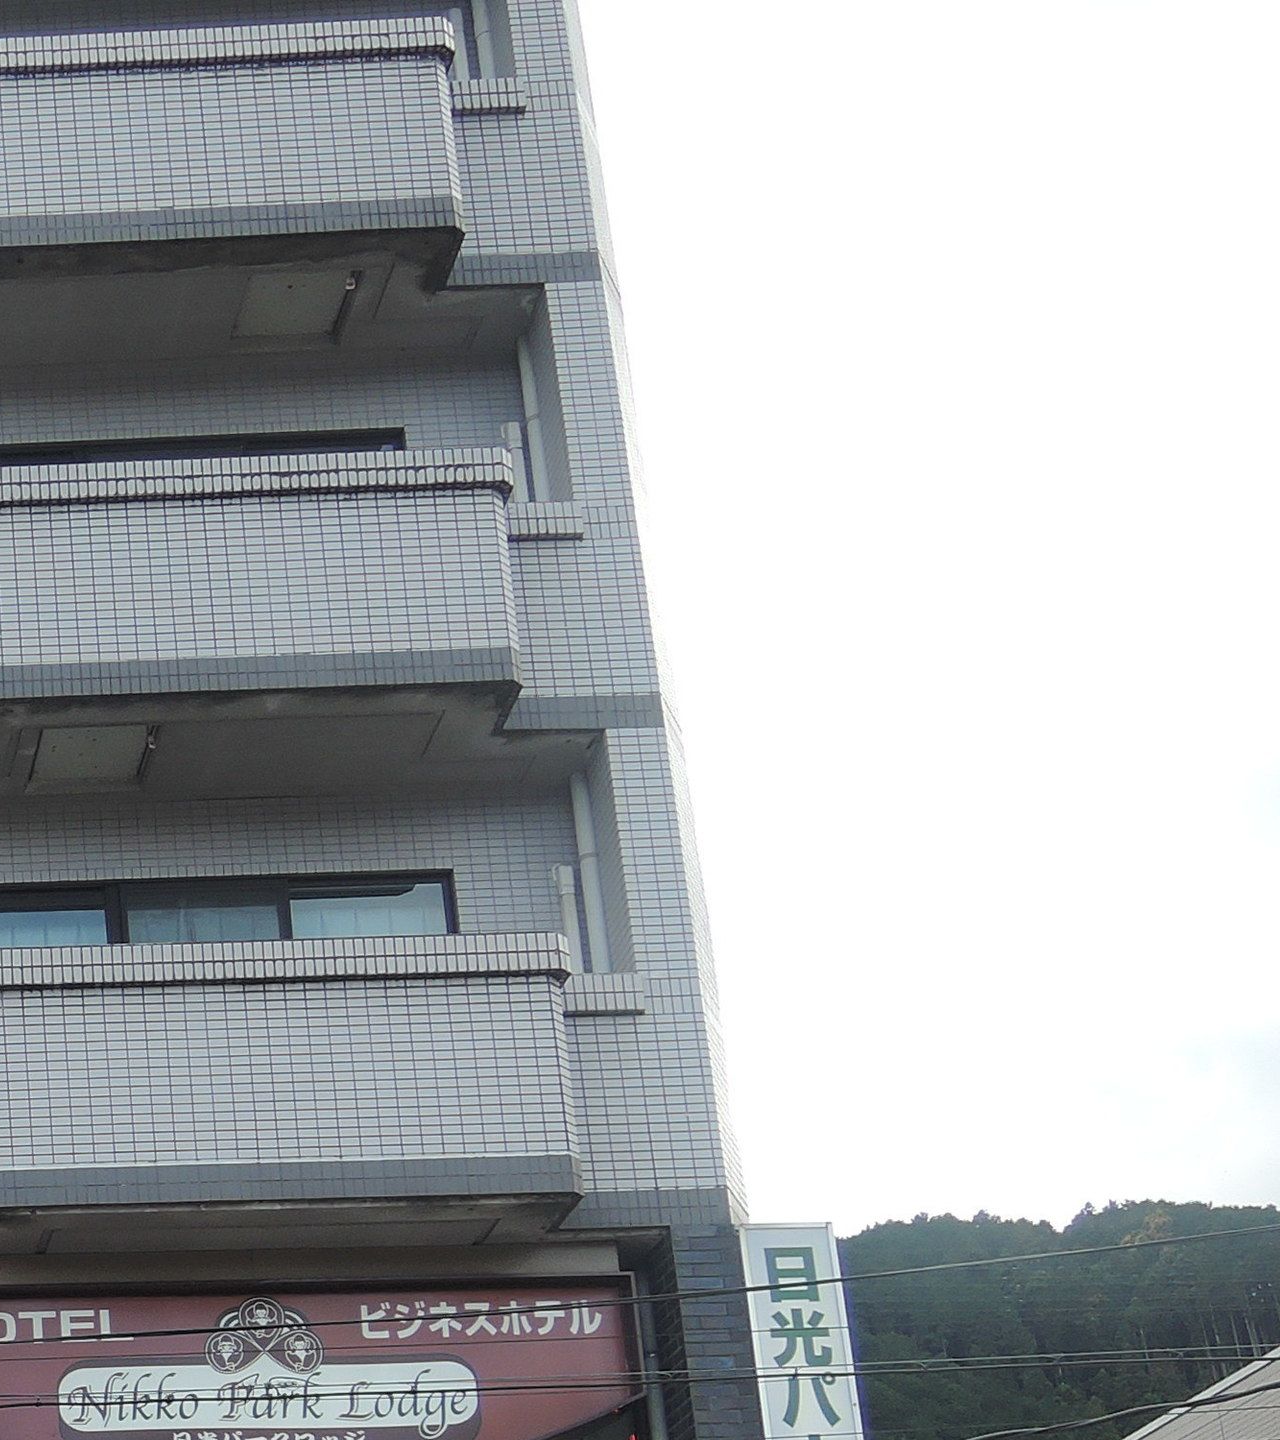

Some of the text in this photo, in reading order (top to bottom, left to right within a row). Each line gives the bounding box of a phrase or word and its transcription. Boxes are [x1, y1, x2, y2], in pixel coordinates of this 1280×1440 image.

[360, 1299, 603, 1339] ビジネスホテル
[67, 1368, 471, 1440] Nikko Park Lodge
